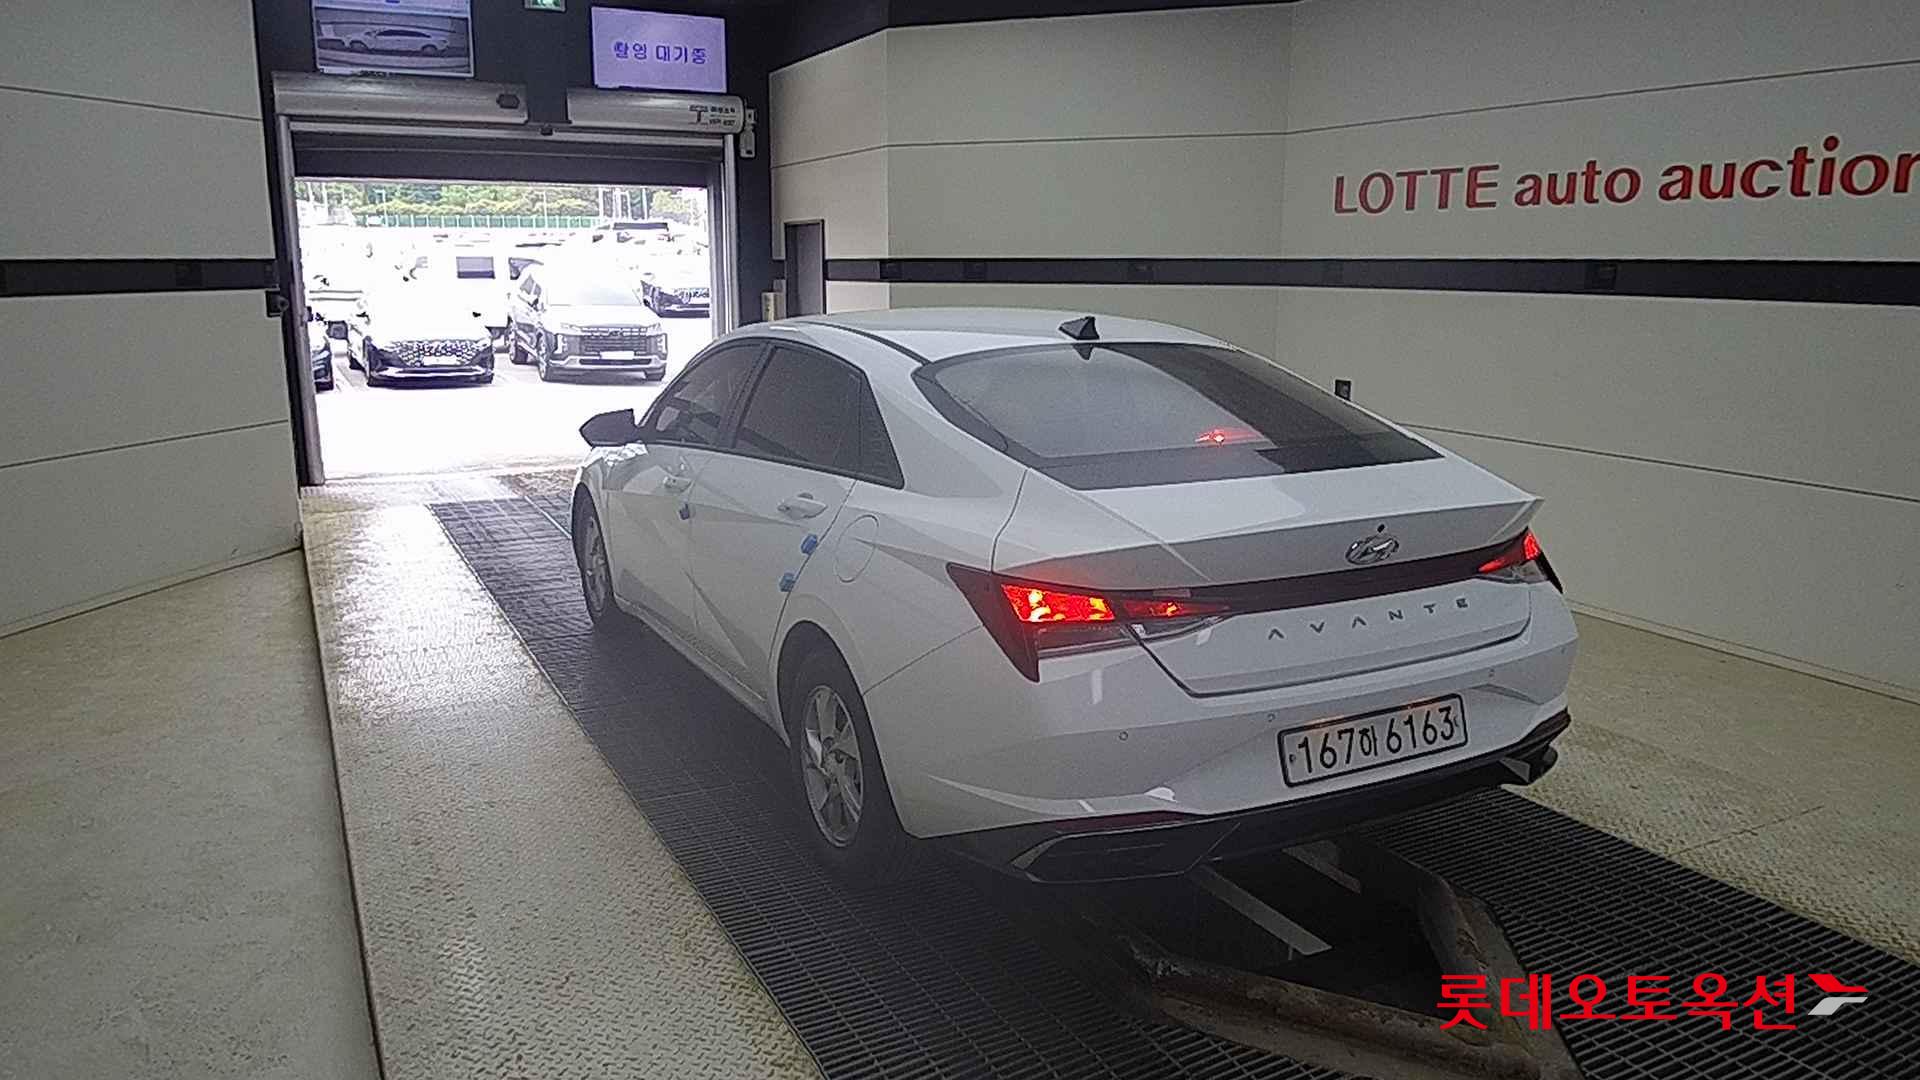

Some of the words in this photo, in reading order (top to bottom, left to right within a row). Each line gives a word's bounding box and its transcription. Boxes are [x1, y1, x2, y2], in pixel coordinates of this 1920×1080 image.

[656, 45, 707, 64] 대기중
[1334, 164, 1500, 214] LOTTE
[1514, 160, 1641, 207] auto
[1268, 597, 1469, 641] AVANTE
